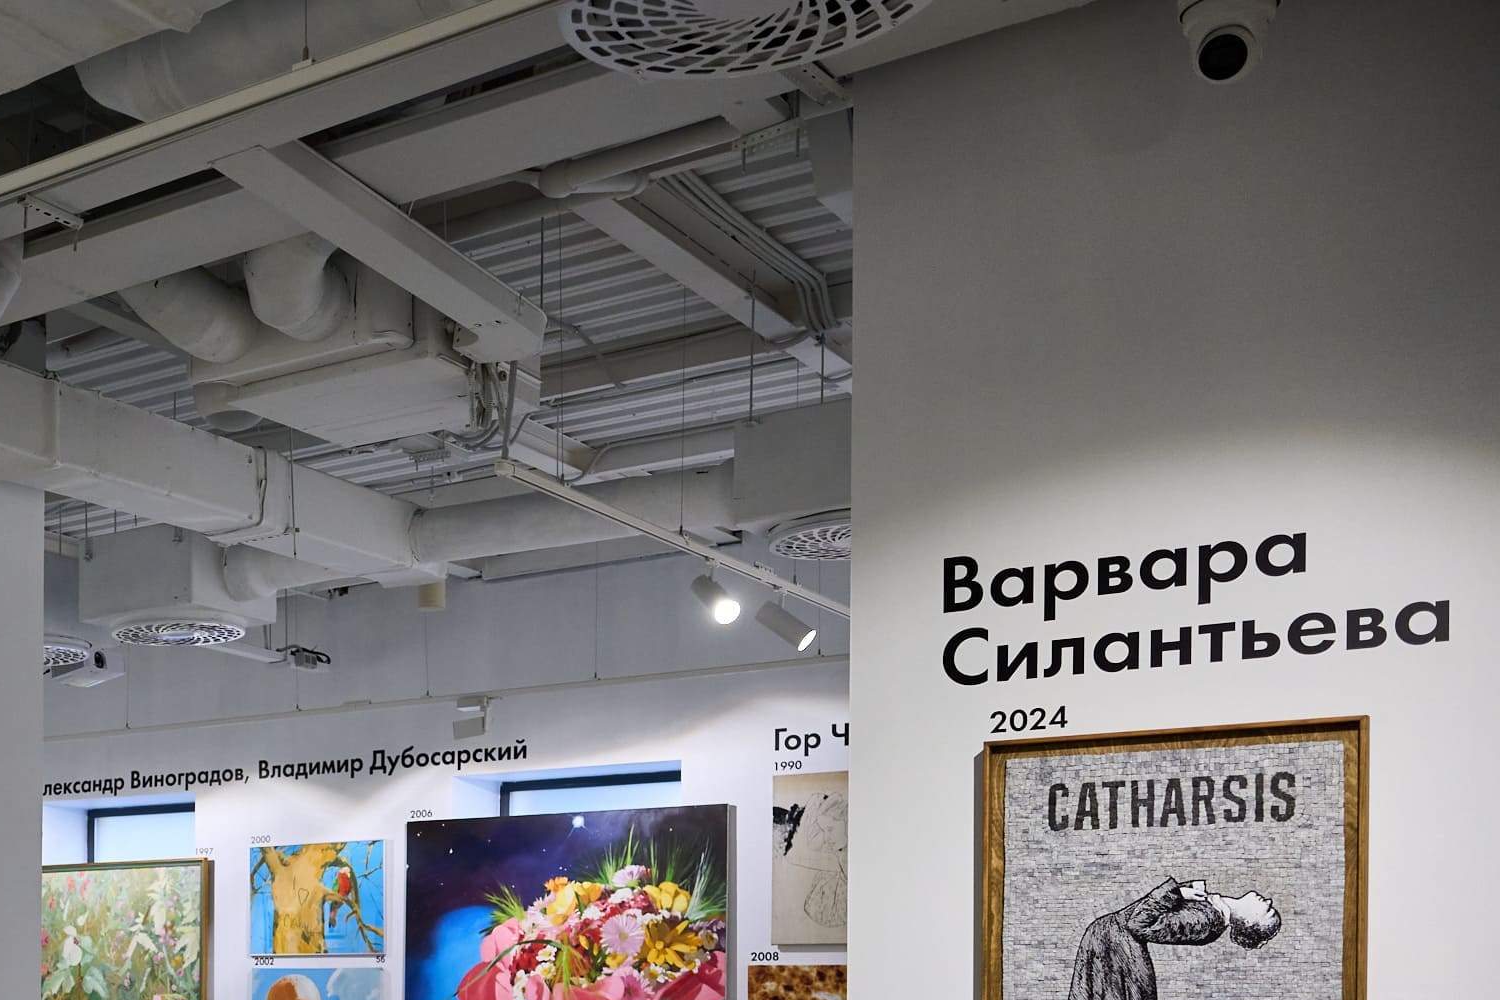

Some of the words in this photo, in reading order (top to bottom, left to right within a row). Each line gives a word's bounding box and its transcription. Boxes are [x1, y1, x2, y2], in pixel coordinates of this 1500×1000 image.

[943, 532, 1307, 620] Варвара
[942, 600, 1450, 686] Силантьева
[990, 705, 1068, 735] 2024
[775, 728, 821, 757] Гор
[42, 777, 125, 797] лександр
[131, 769, 249, 792] Виноградов,
[258, 757, 364, 780] Владимир
[369, 739, 528, 775] Дубосарский
[775, 761, 802, 771] 1990
[1047, 771, 1296, 832] CATHARSIS
[410, 810, 433, 819] 2006
[251, 835, 271, 845] 2000
[195, 847, 214, 856] 1997
[254, 956, 274, 966] 2002
[376, 955, 386, 963] 56
[750, 951, 780, 962] 2008
